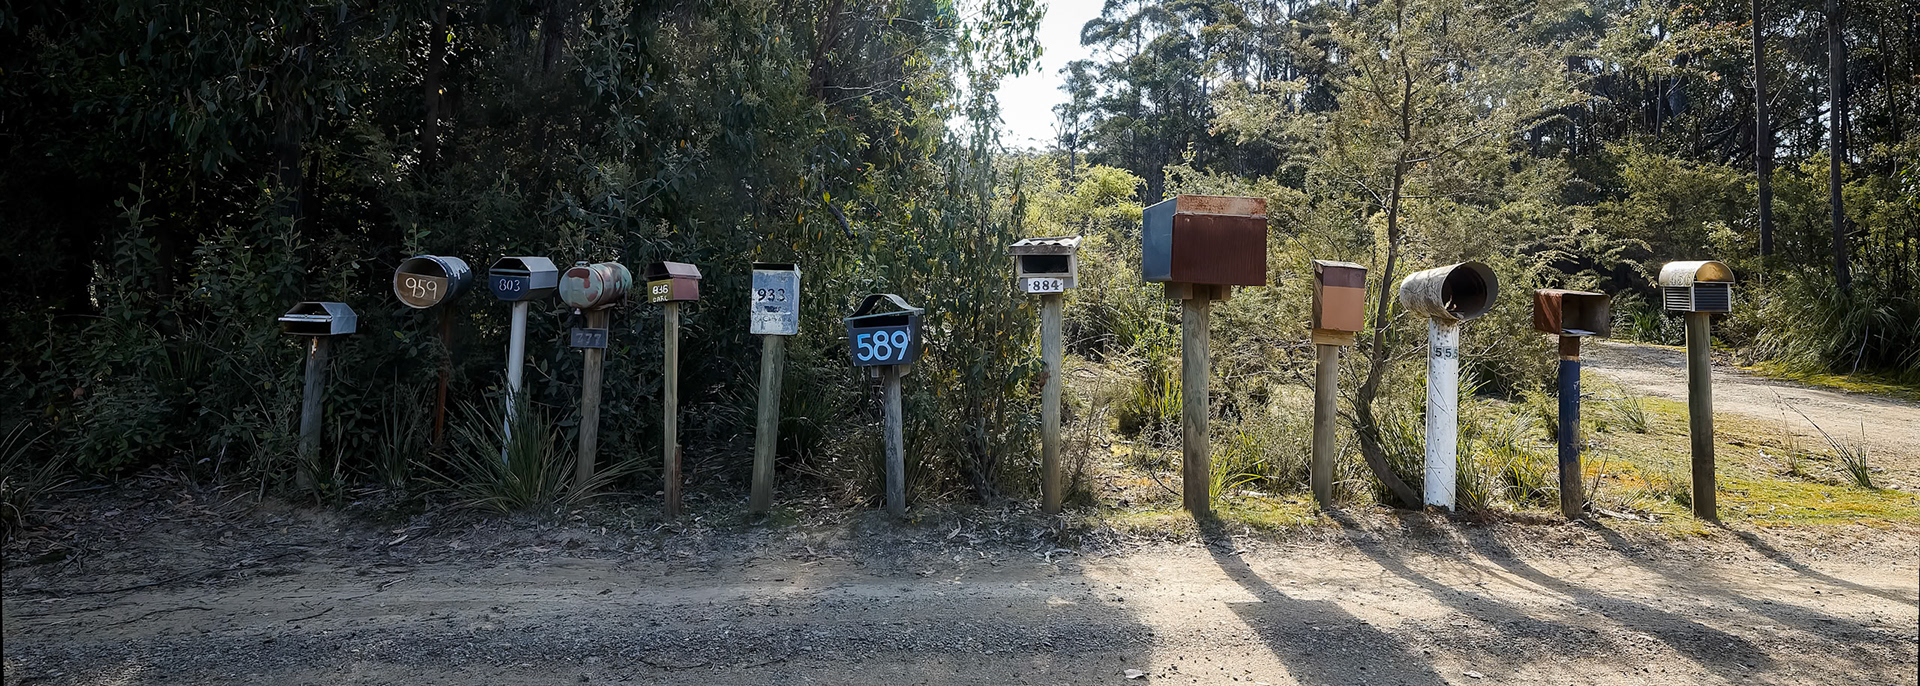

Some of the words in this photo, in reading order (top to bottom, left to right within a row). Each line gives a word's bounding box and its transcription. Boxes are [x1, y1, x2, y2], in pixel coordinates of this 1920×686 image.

[405, 277, 438, 300] 959
[499, 278, 520, 292] 803
[1033, 280, 1060, 291] 884
[758, 288, 785, 302] 933
[857, 330, 909, 361] 589
